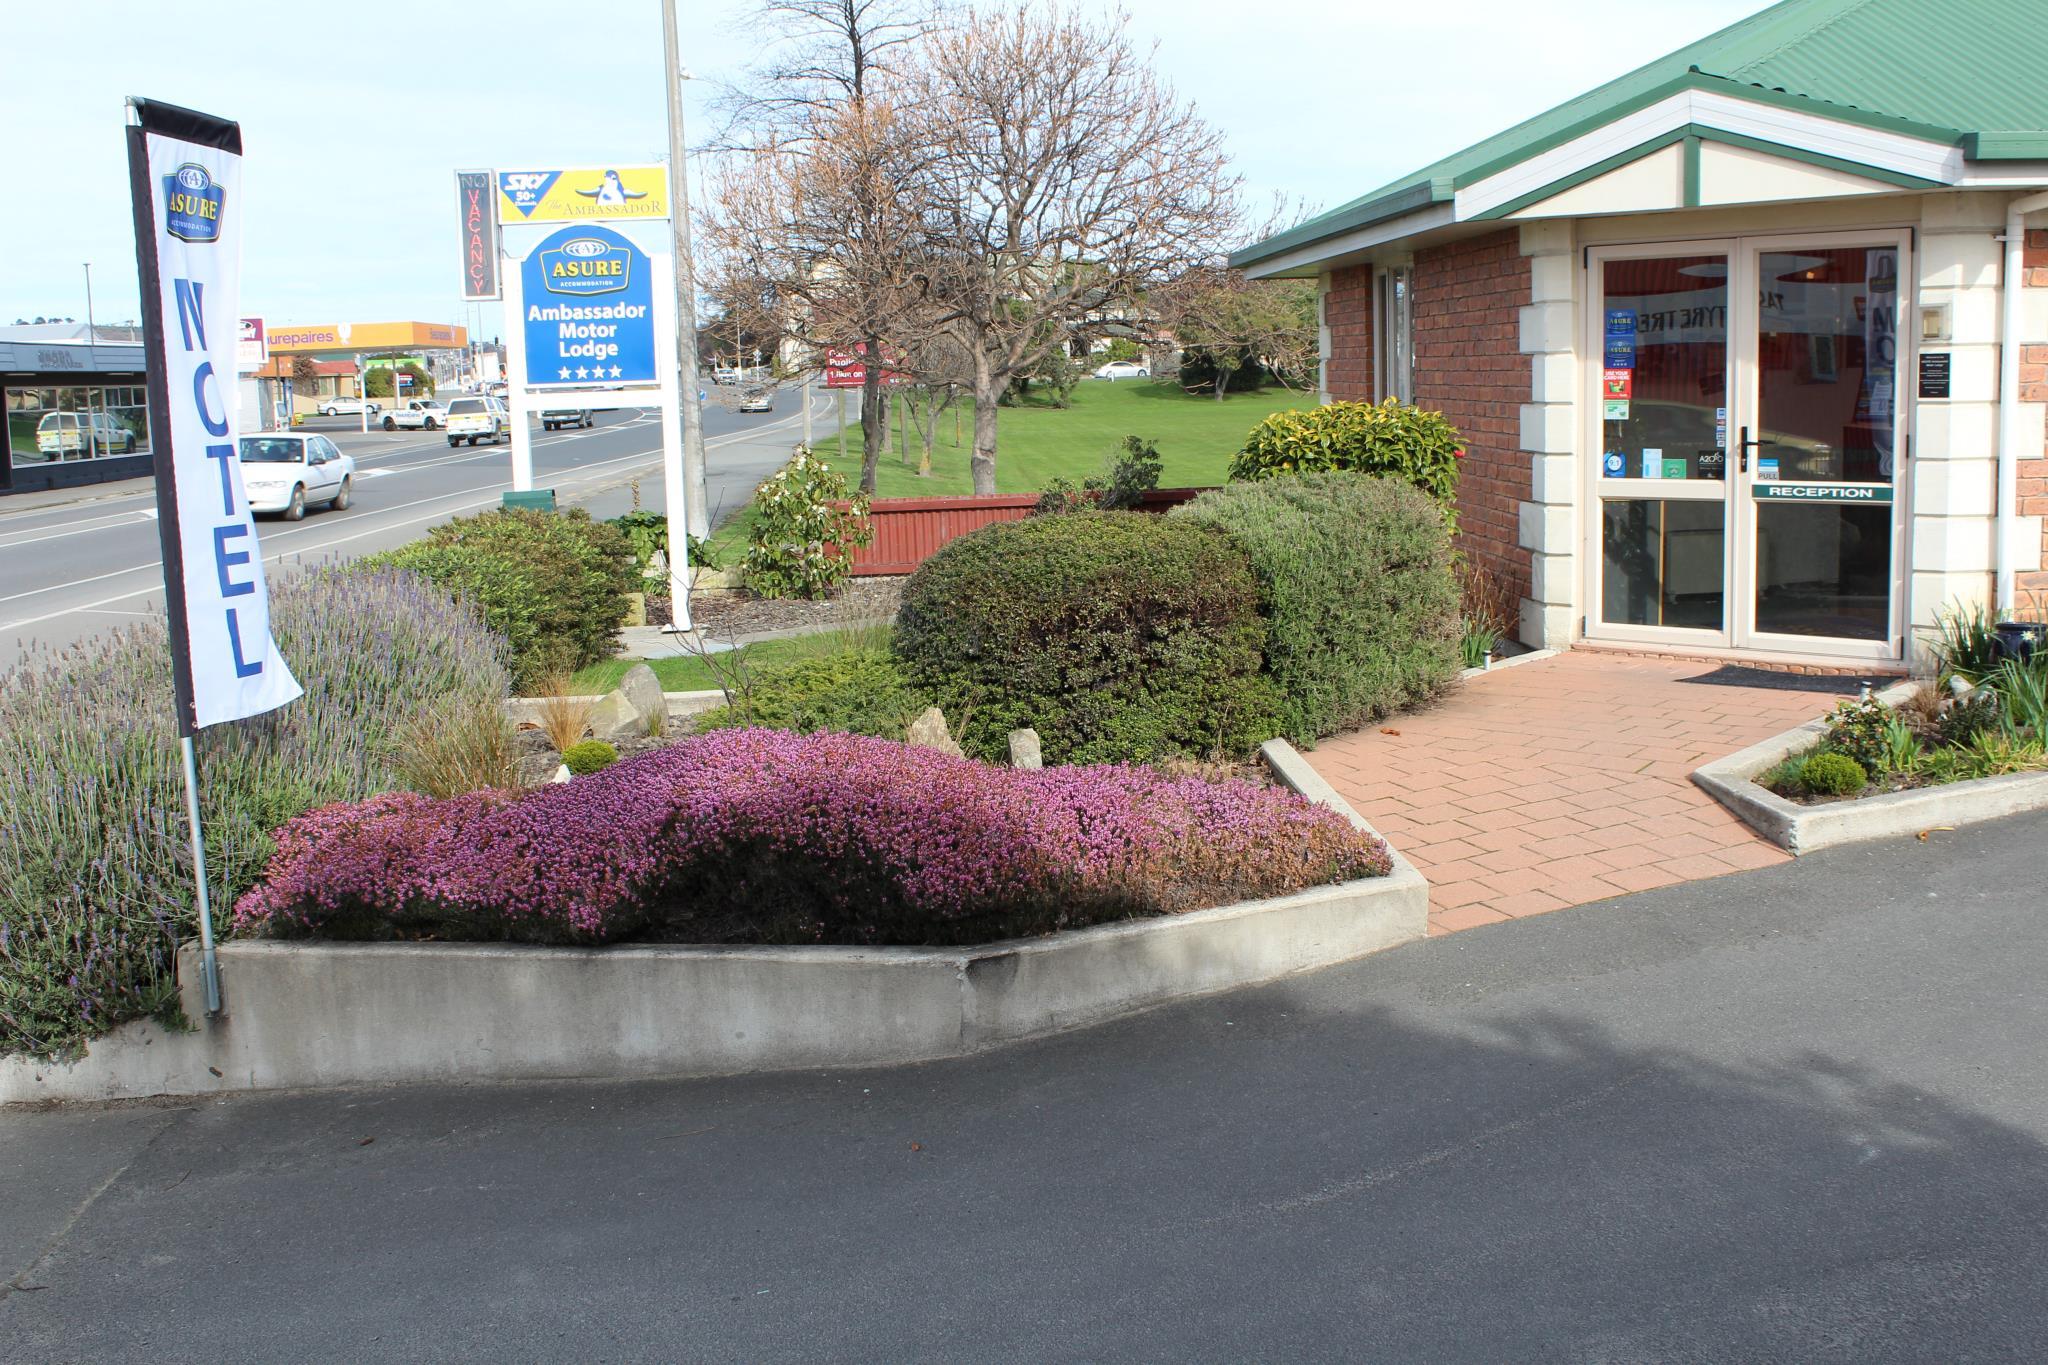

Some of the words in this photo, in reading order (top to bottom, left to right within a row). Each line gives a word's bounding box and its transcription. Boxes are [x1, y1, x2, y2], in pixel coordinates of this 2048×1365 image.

[504, 173, 551, 191] SKY
[516, 191, 536, 201] 50+
[169, 191, 218, 221] ASURE
[563, 201, 662, 216] AMBASSADOR
[468, 189, 484, 295] VACANCY
[552, 260, 623, 278] ASURE
[528, 301, 647, 321] Ambassador
[559, 322, 618, 339] Motor
[559, 340, 619, 361] Lodge
[1758, 472, 1777, 480] PULL
[1768, 486, 1873, 498] RECEPTION
